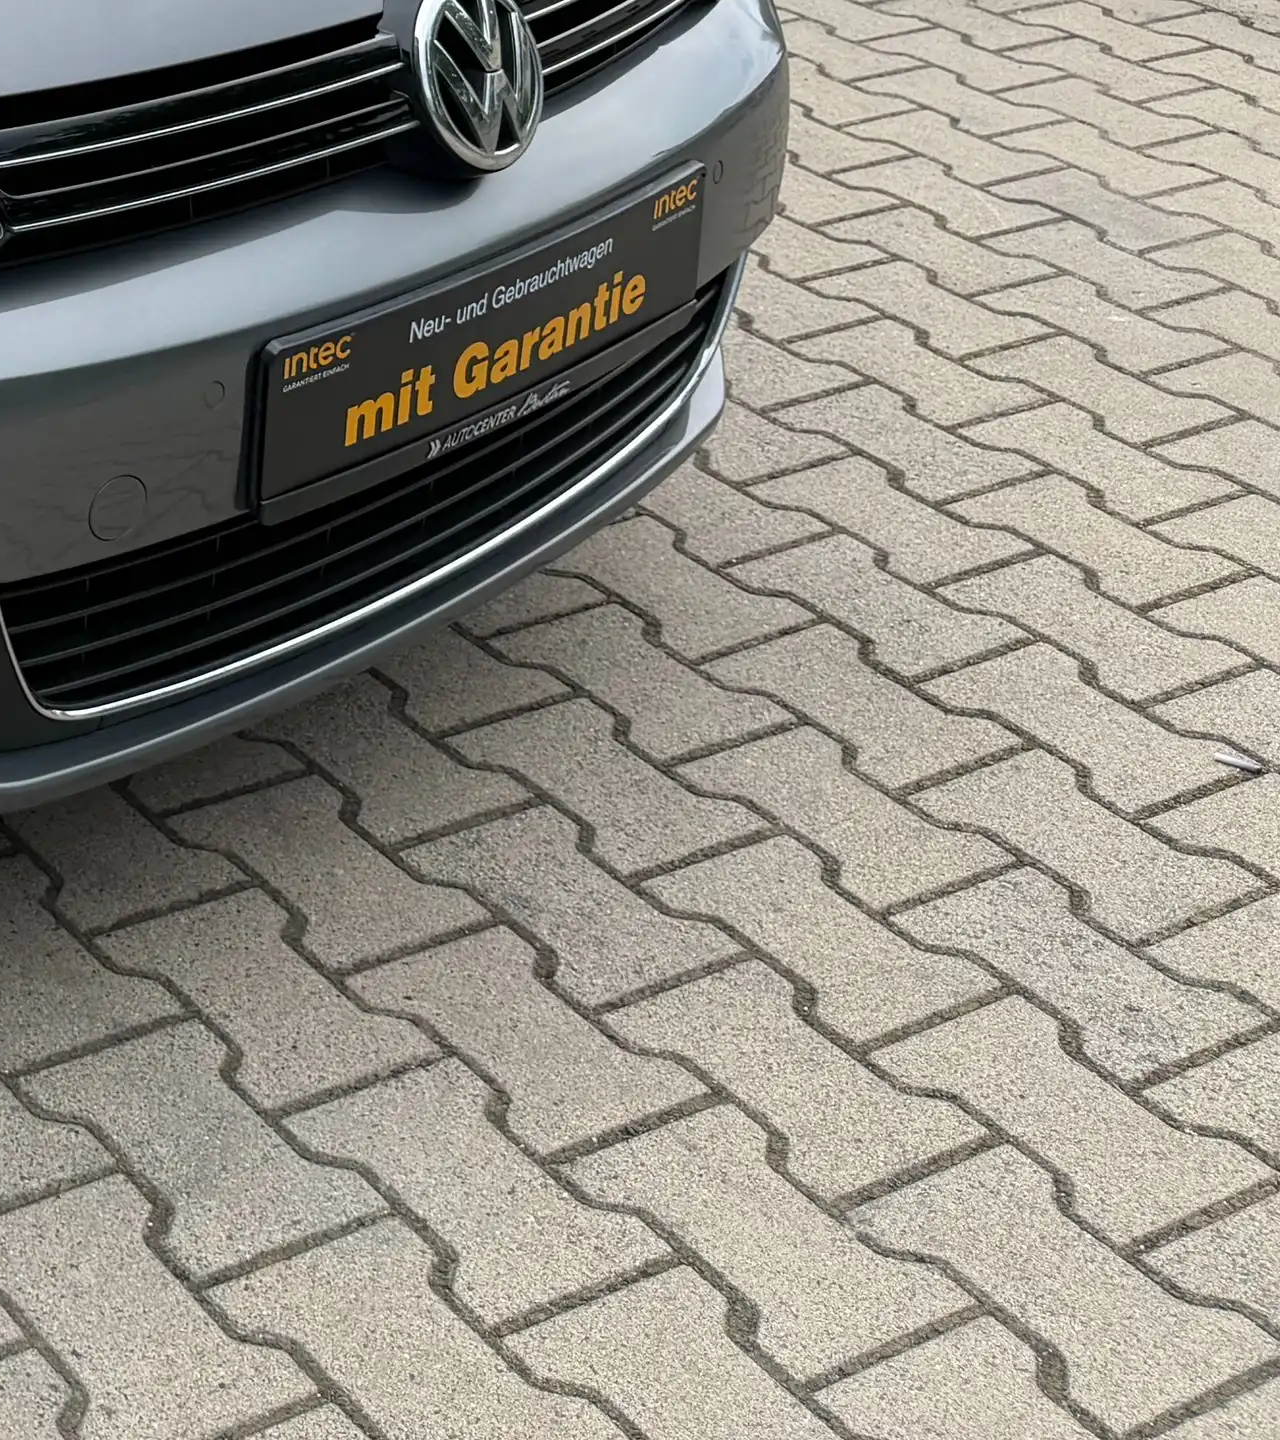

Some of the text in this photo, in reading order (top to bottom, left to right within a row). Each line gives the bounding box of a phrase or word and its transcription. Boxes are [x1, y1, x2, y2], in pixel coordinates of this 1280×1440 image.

[653, 178, 698, 220] intec
[408, 237, 614, 343] Neu- und Gebrauchtwagen
[283, 335, 352, 380] intec
[344, 269, 647, 447] mit Garantie
[282, 372, 321, 393] GARANTIERT
[441, 405, 516, 453] AUTOCENTER
